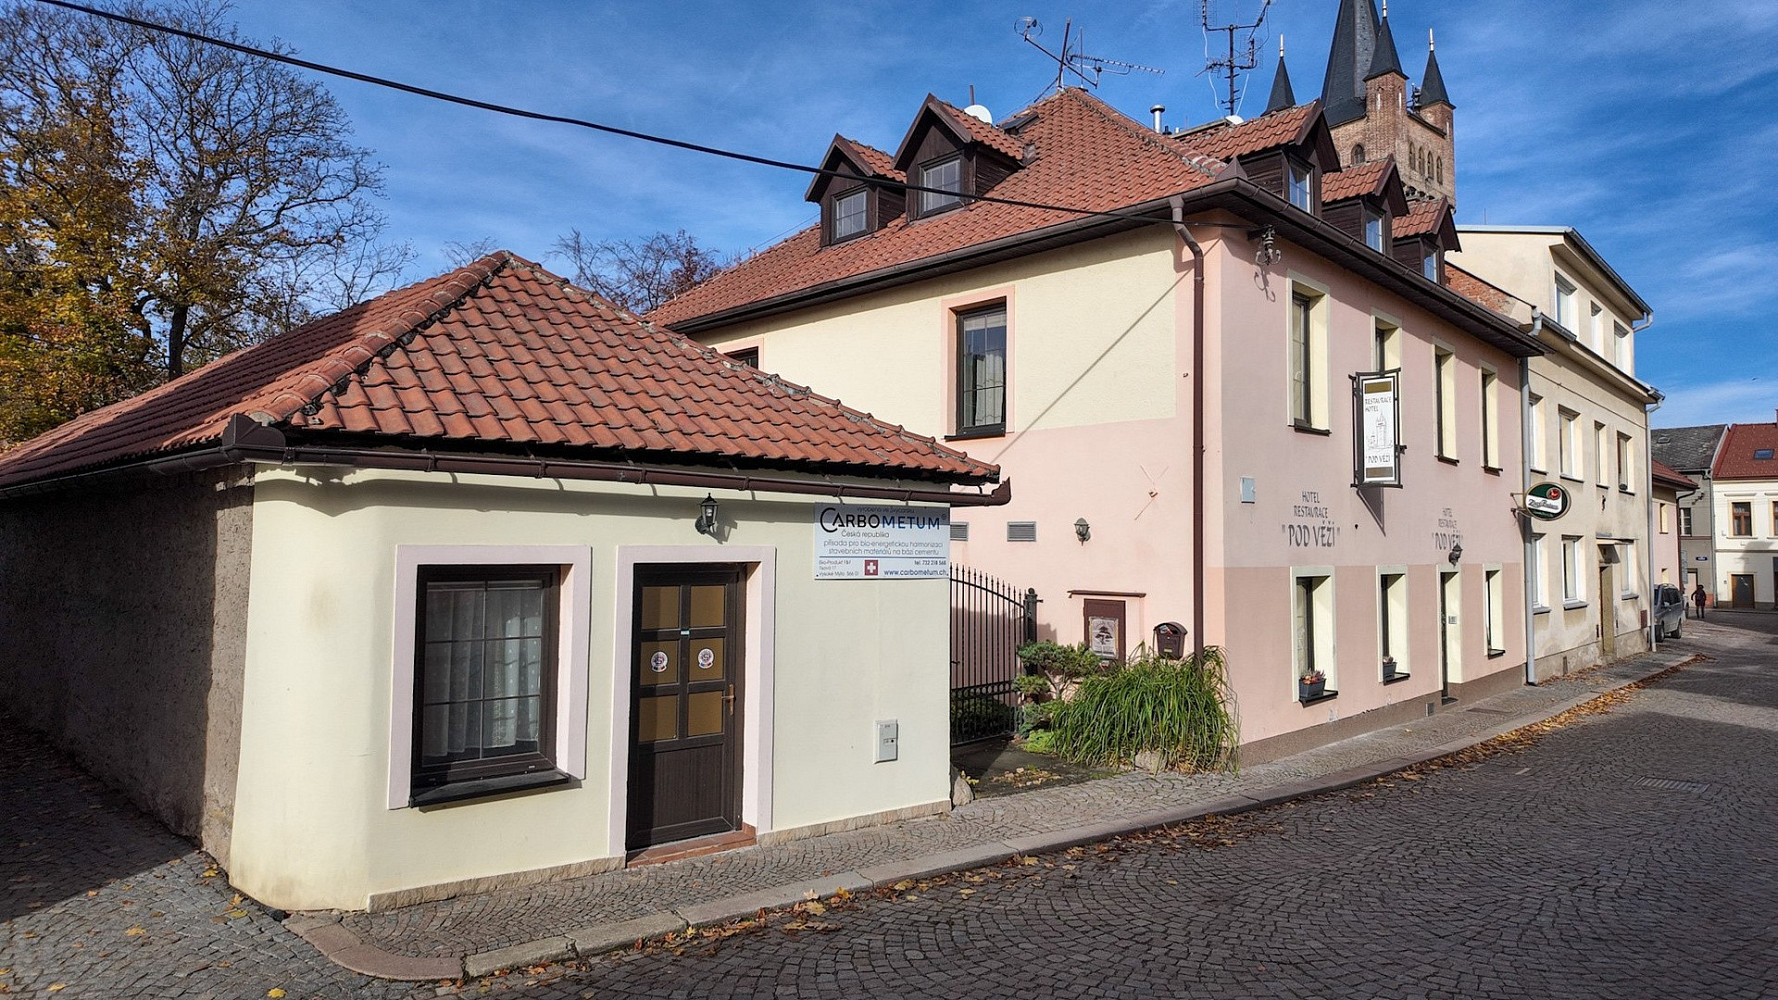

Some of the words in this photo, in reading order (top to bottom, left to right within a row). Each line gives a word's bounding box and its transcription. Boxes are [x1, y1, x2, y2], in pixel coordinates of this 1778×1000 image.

[1301, 491, 1320, 504] HOTEL
[1293, 504, 1329, 519] RESTAURACE
[841, 529, 861, 538] Česká
[861, 530, 890, 539] republika
